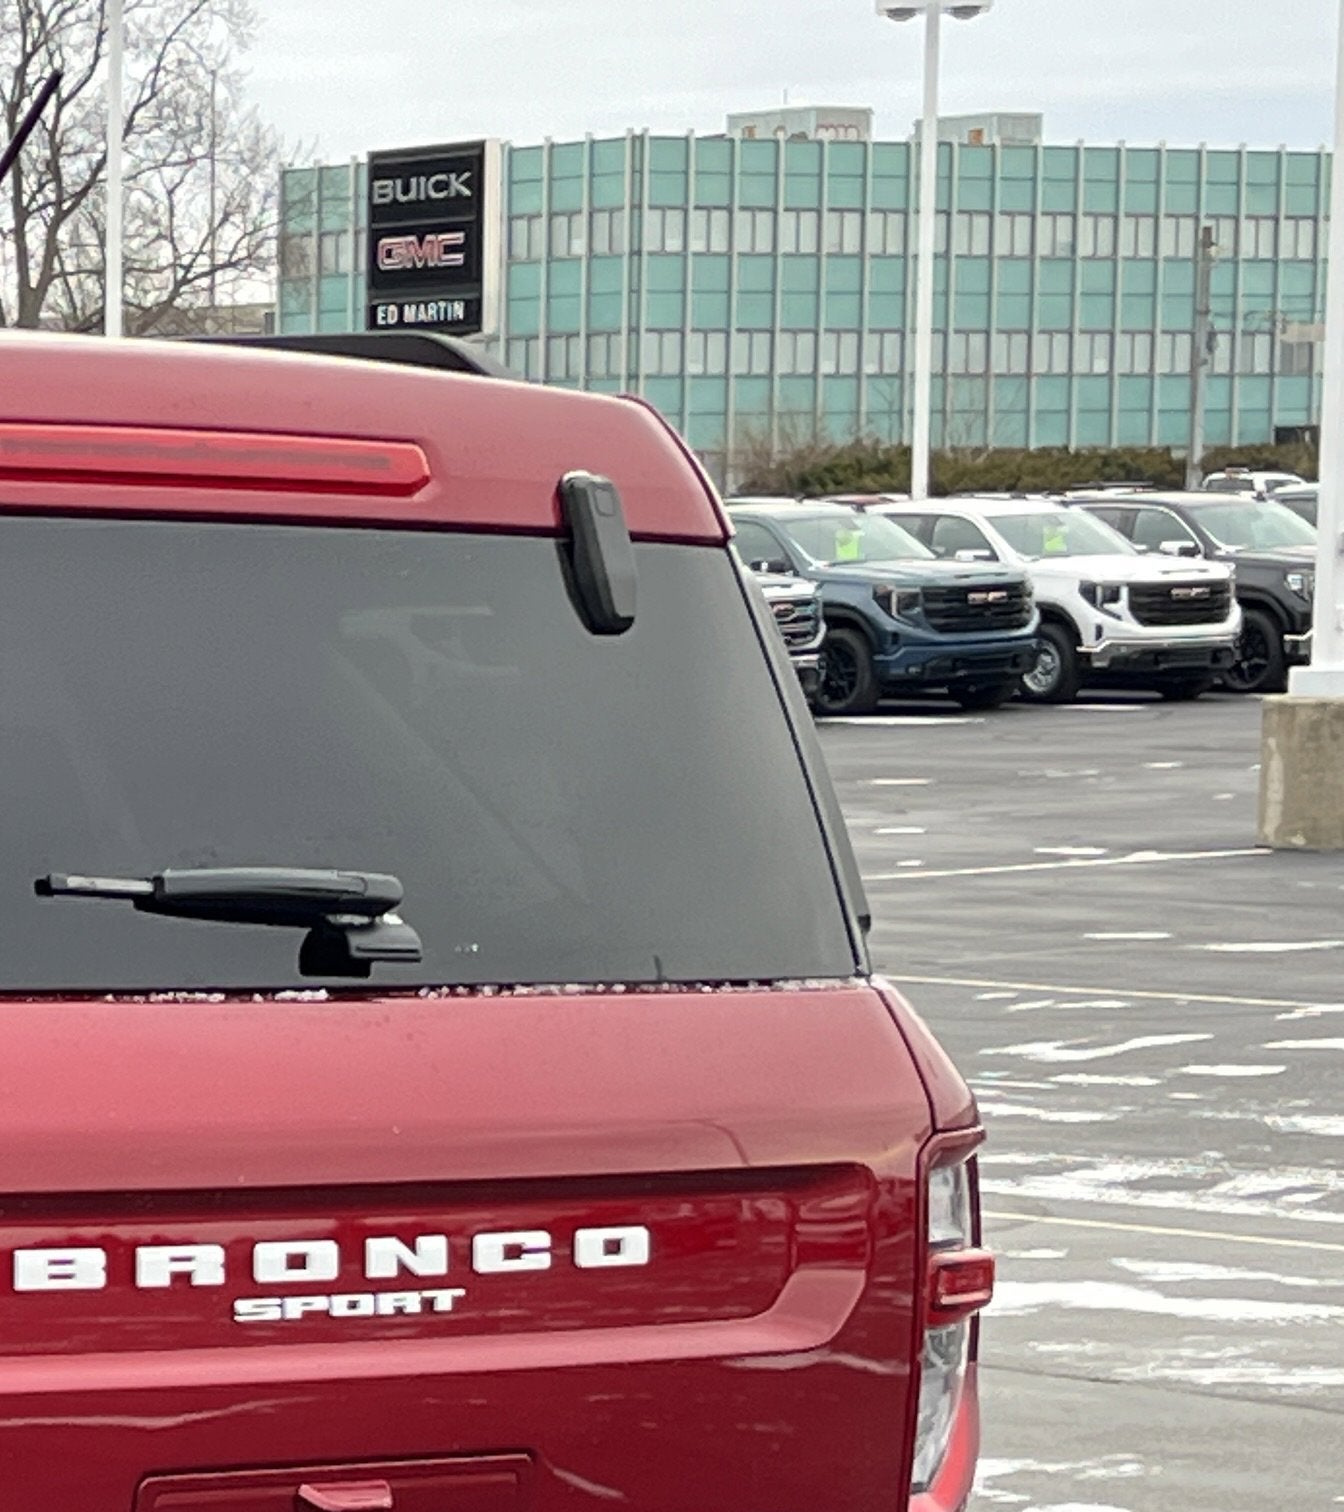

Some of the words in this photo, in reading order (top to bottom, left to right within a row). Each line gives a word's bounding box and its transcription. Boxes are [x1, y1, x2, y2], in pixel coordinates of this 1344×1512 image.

[372, 171, 472, 205] BUICK
[377, 232, 465, 271] GMC
[377, 304, 397, 325] ED
[403, 301, 464, 324] MARTIN
[13, 1225, 650, 1291] BRONCO
[233, 1288, 466, 1322] SPORT
